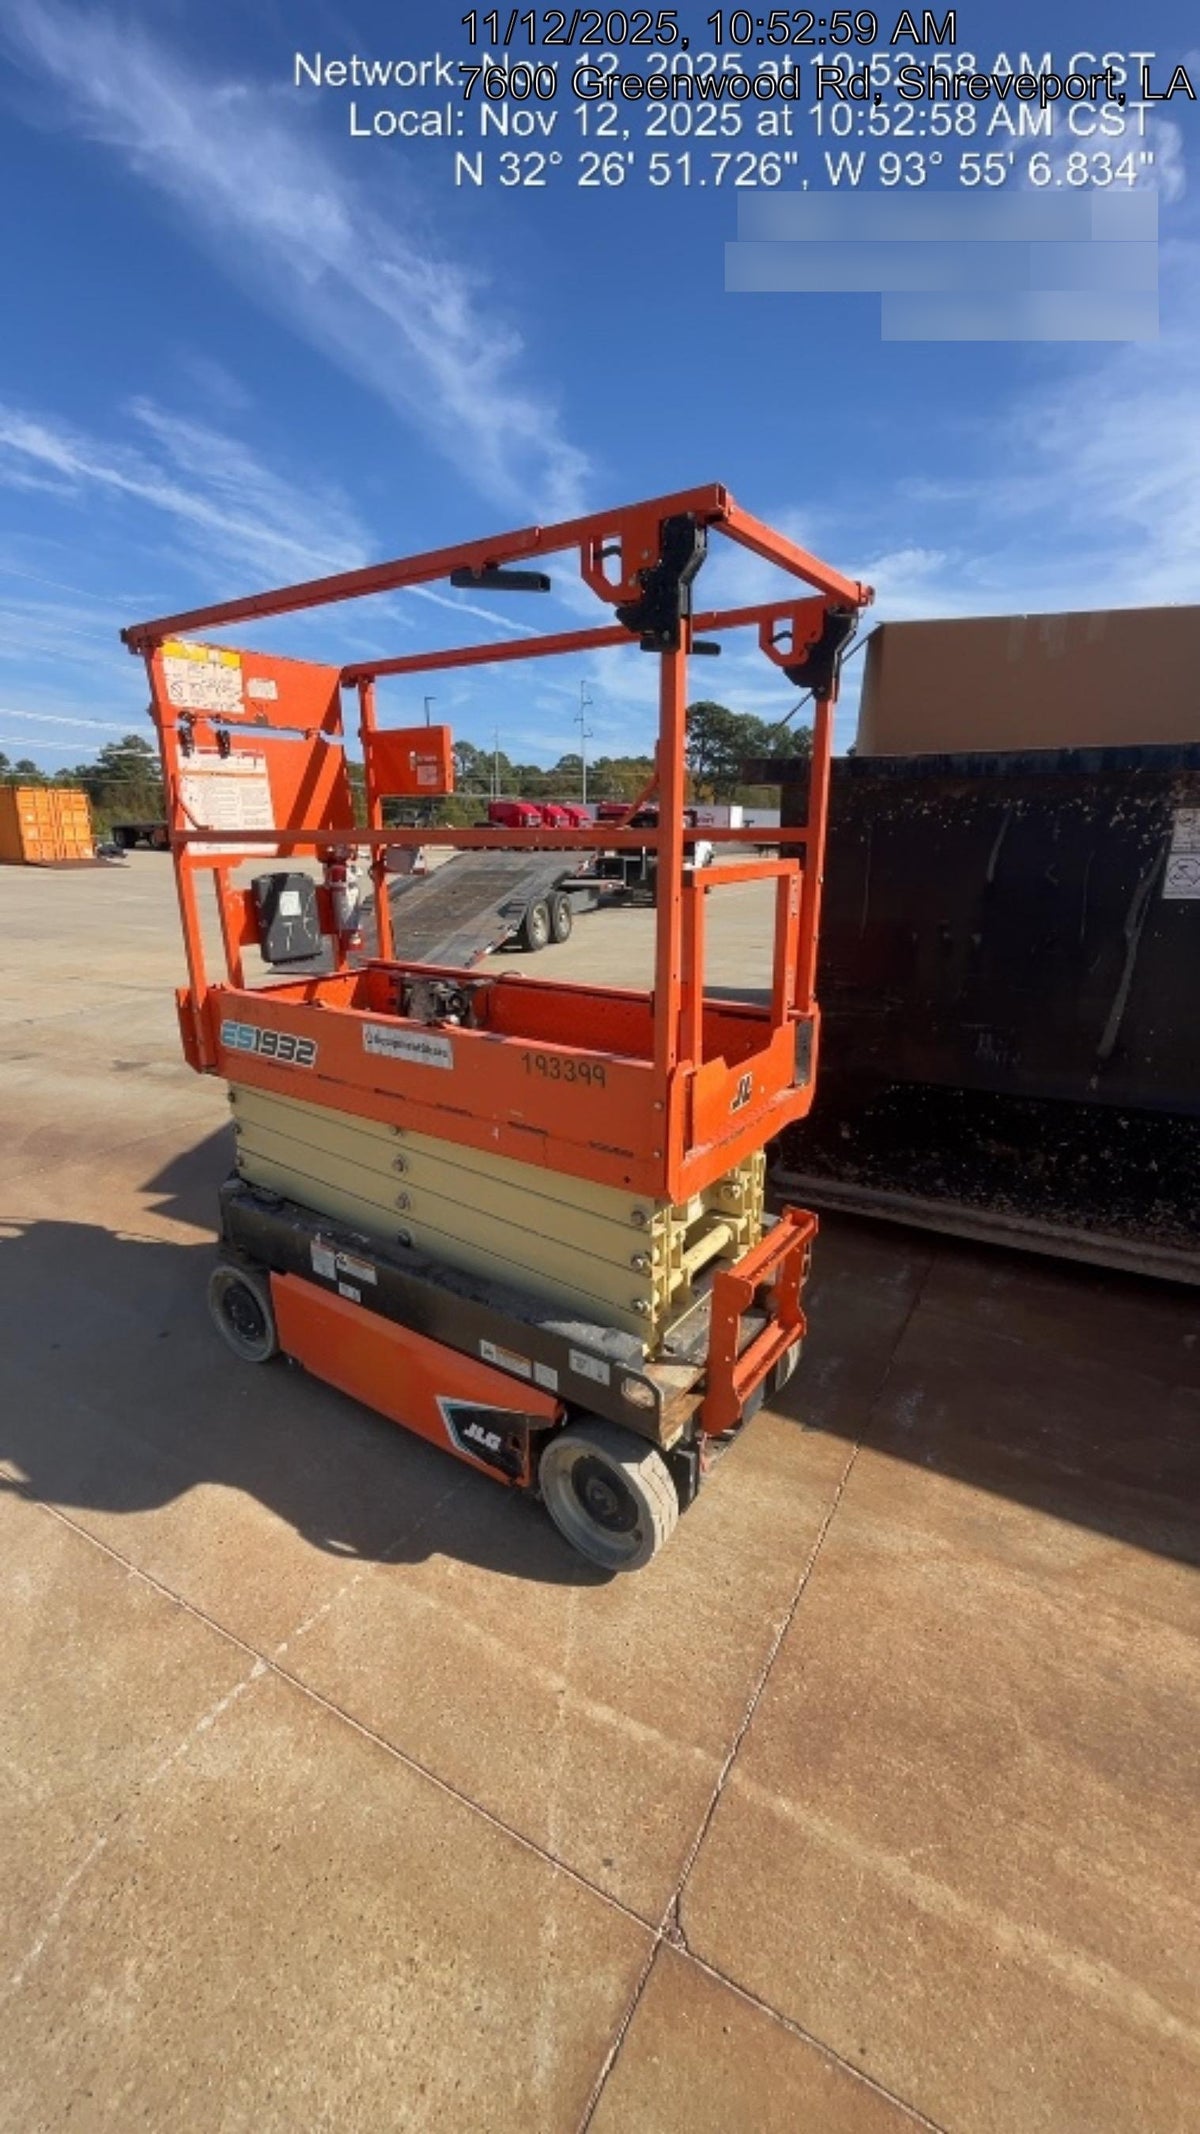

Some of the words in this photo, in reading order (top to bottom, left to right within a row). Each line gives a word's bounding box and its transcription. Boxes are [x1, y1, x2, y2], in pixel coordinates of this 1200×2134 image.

[221, 1020, 317, 1068] ES1932
[521, 1052, 606, 1089] 193399
[464, 1422, 501, 1451] JLG
